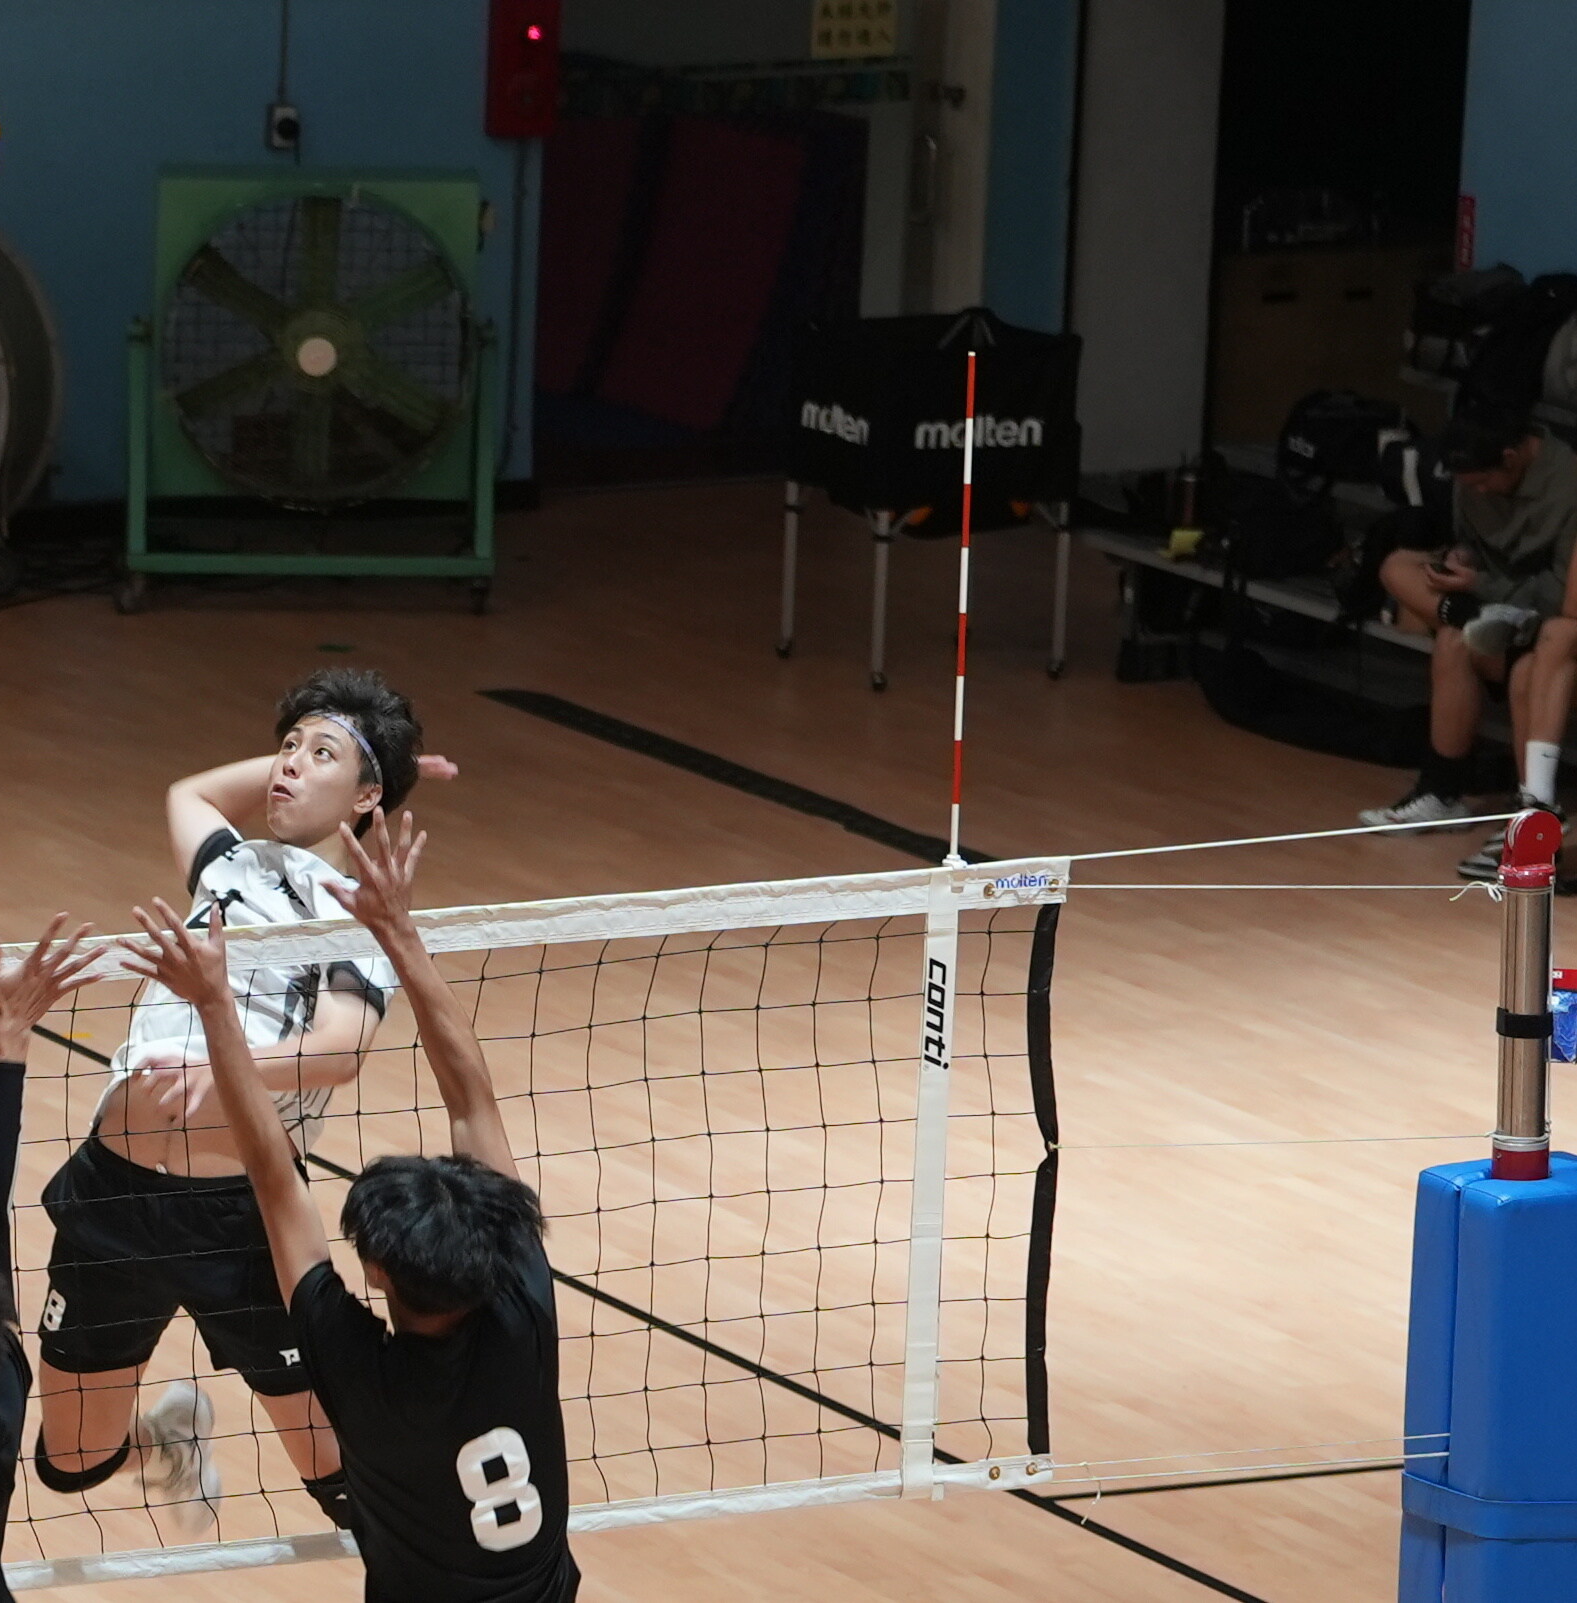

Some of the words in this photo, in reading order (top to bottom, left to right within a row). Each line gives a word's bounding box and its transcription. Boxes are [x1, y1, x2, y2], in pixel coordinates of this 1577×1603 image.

[995, 873, 1047, 889] molten
[924, 957, 949, 1070] conti
[42, 1288, 67, 1332] 8
[456, 1426, 543, 1552] 8
